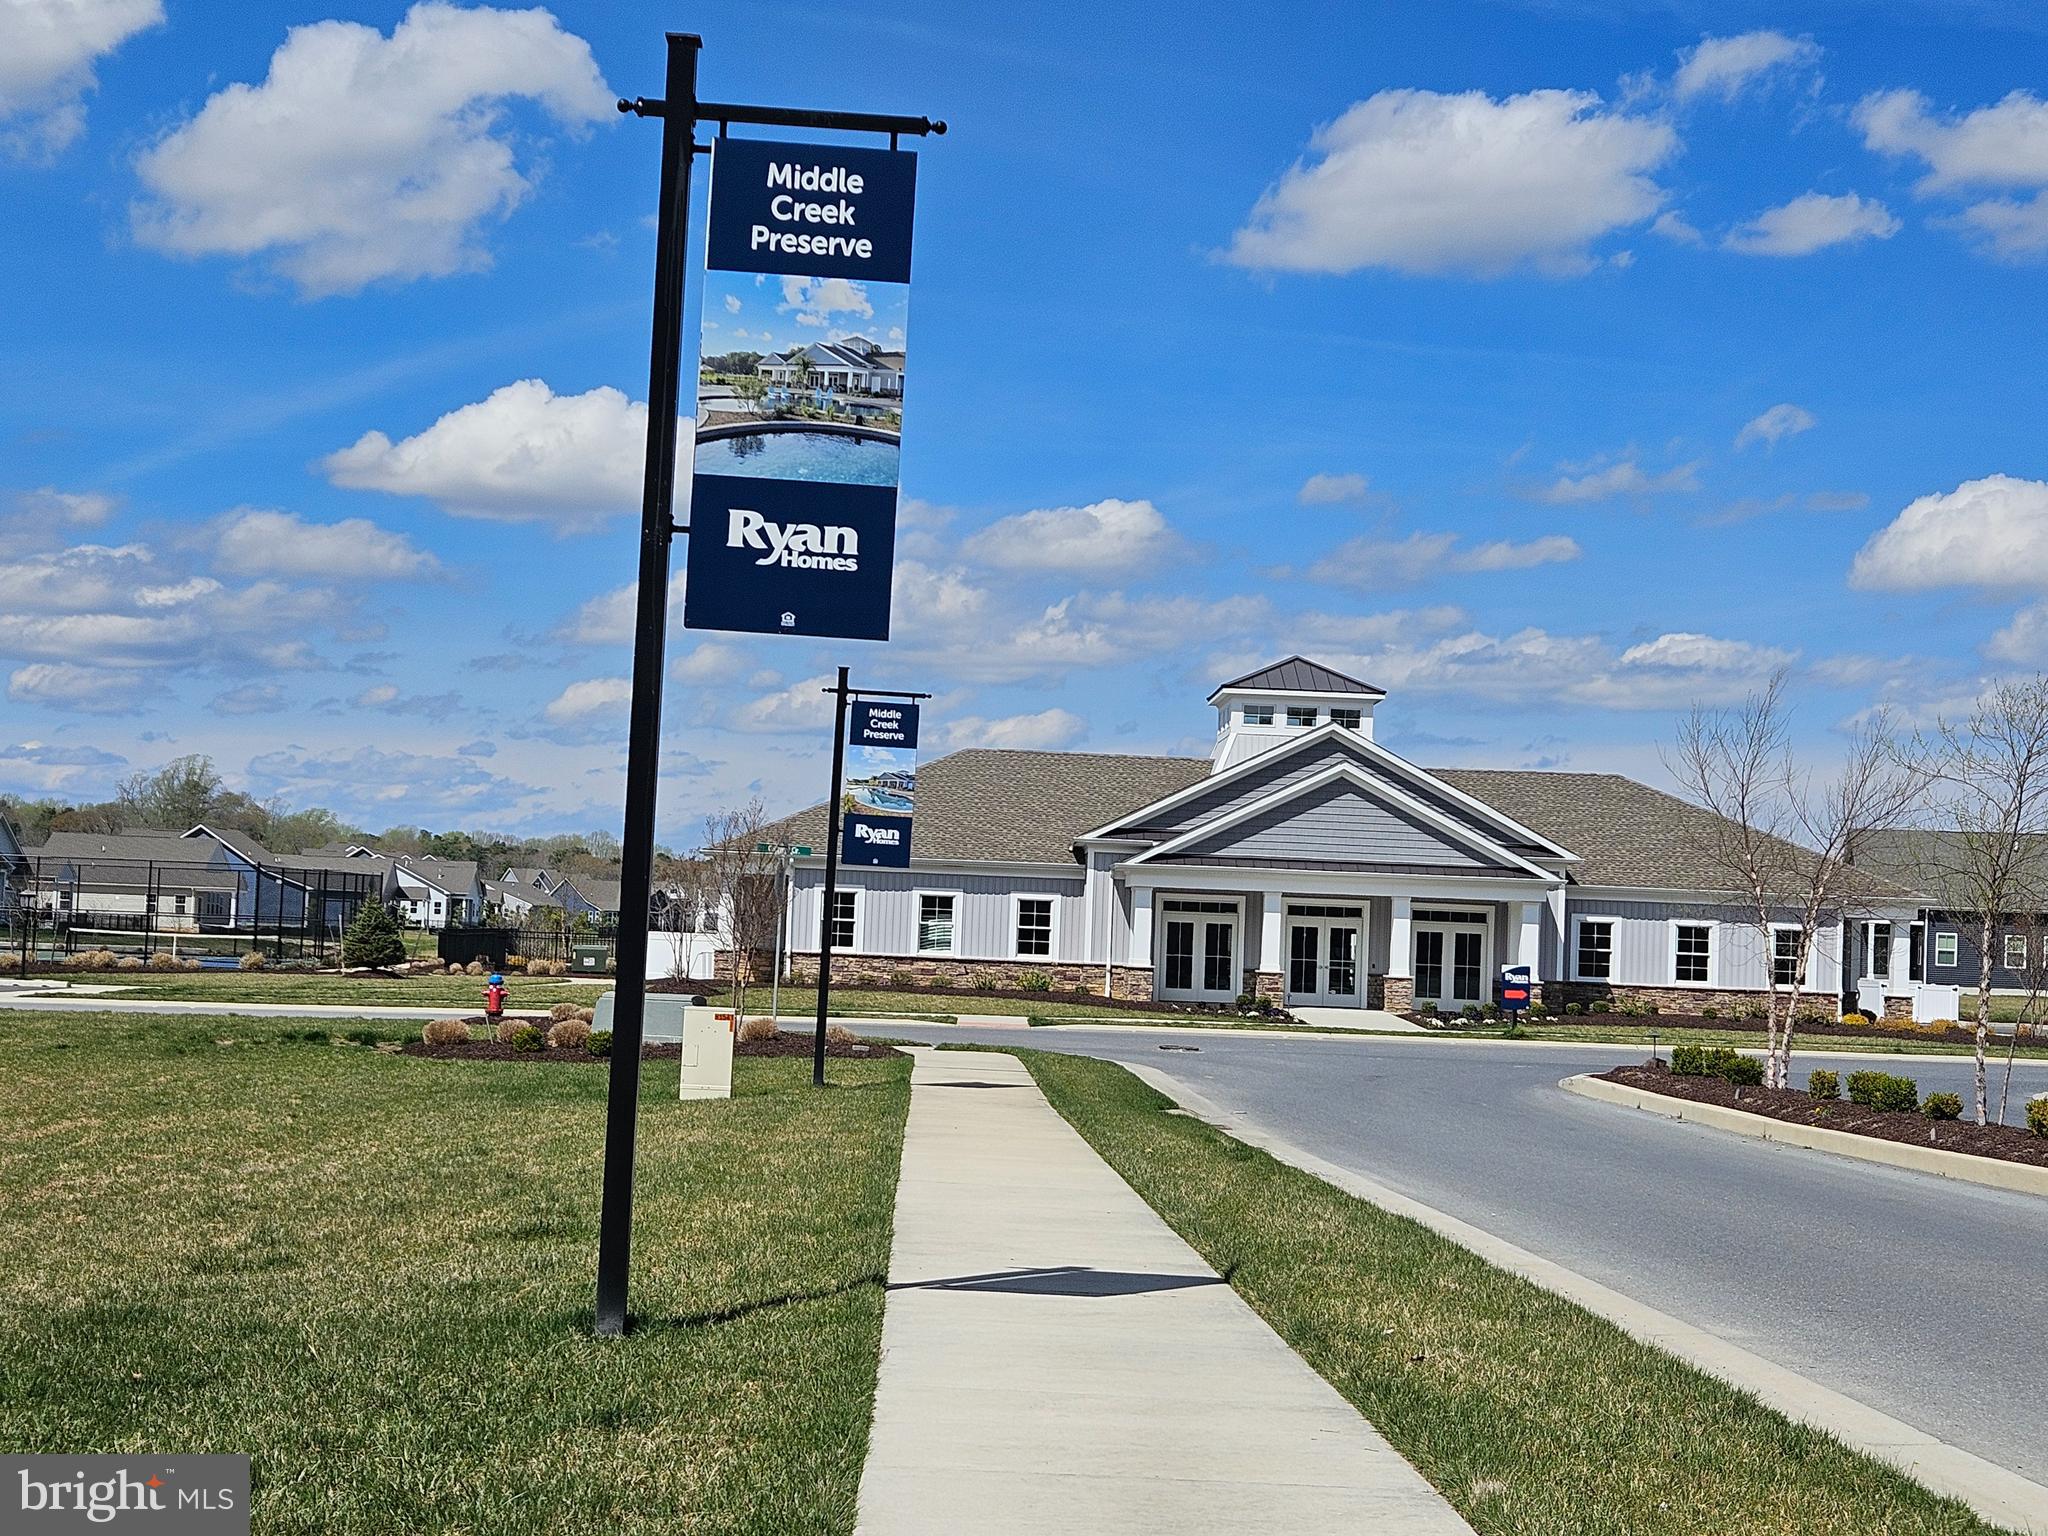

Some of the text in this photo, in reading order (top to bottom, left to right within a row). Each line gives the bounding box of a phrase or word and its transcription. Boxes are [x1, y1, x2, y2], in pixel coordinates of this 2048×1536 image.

[766, 162, 865, 195] Middle
[770, 194, 856, 226] Creek
[751, 224, 873, 259] Preserve
[726, 508, 859, 566] Ryan
[780, 549, 859, 572] Homes
[868, 708, 902, 720] Middle
[870, 718, 899, 730] Creek
[863, 728, 905, 741] Preserve
[855, 823, 900, 844] Ryan
[1504, 972, 1529, 984] Ryan
